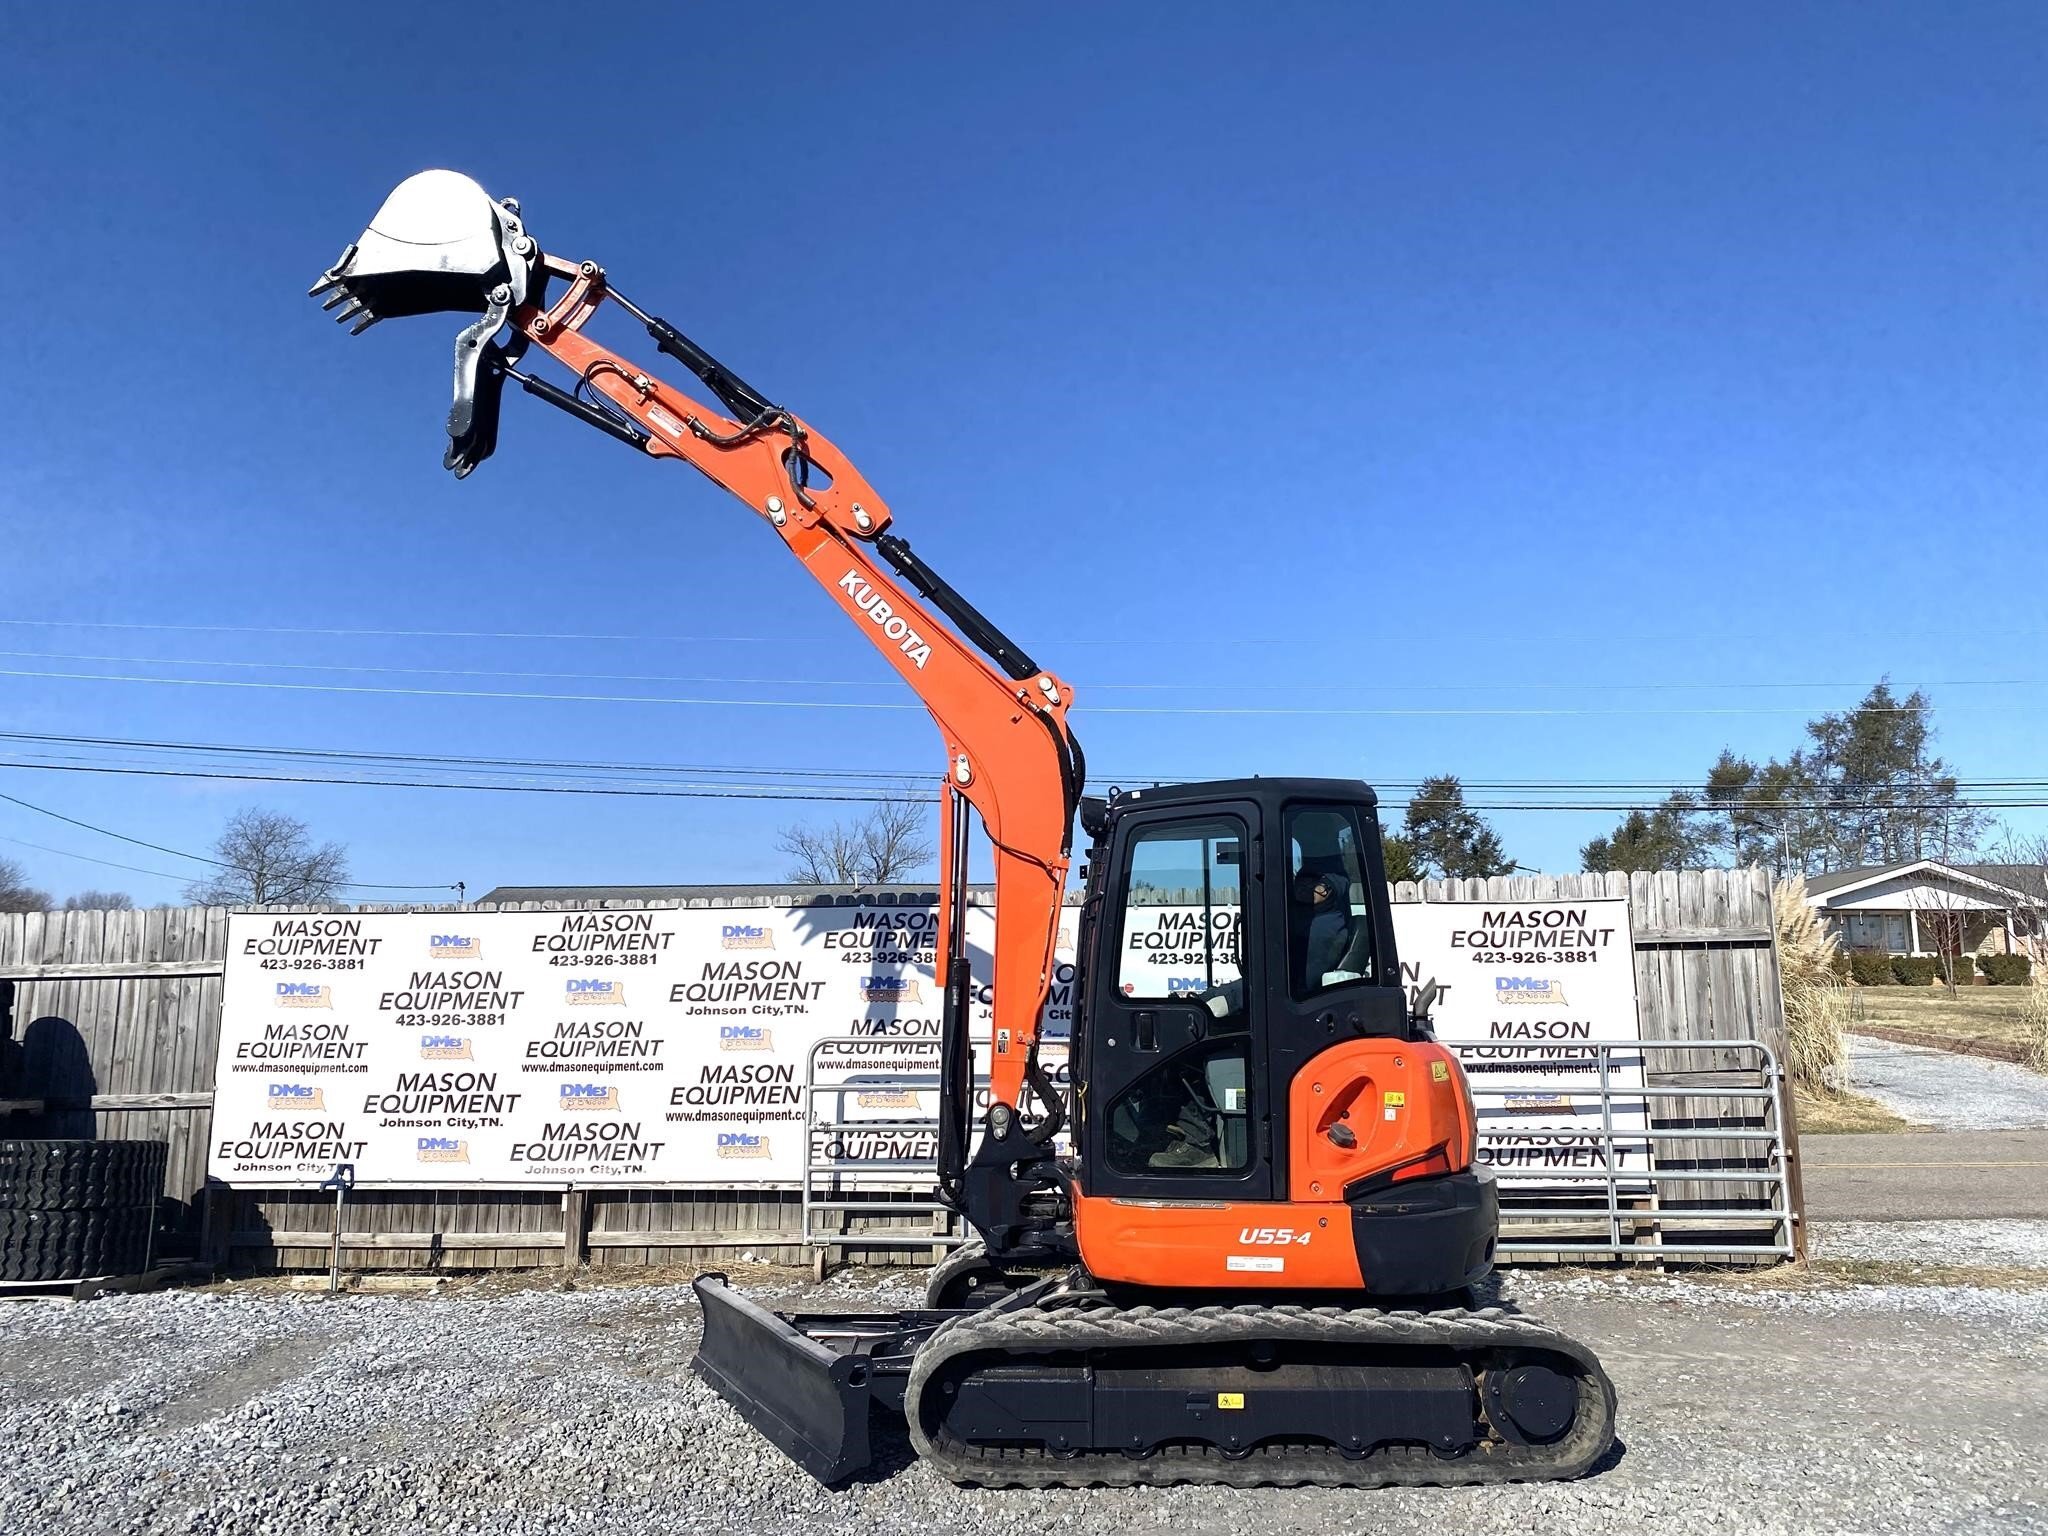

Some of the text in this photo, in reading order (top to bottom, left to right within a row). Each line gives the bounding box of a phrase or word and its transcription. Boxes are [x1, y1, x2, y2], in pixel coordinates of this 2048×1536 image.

[838, 568, 933, 670] KUBOTA
[562, 914, 653, 932] MASON
[1482, 910, 1587, 929] MASON
[272, 920, 361, 937] MASON
[243, 939, 382, 955] EQUIPMENT
[532, 932, 675, 952] EQUIPMENT
[823, 931, 939, 949] EQUIPME
[1450, 929, 1615, 948] EQUIPMENT
[260, 959, 364, 970] 423-926-3881
[549, 953, 657, 966] 423-926-3881
[1472, 951, 1597, 964] 423-926-3881
[701, 961, 801, 981] MASON
[409, 971, 502, 989] MASON
[379, 991, 525, 1010] EQUIPMENT
[669, 981, 826, 1003] EQUIPMENT
[685, 1005, 809, 1016] Johnson City,TN.
[395, 1013, 505, 1026] 423-926-3881
[850, 1019, 941, 1036] MASON
[264, 1024, 349, 1041] MASON
[554, 1021, 643, 1039] MASON
[1489, 1021, 1591, 1039] MASON
[236, 1042, 368, 1058] EQUIPMENT
[526, 1040, 664, 1057] EQUIPMENT
[231, 1062, 369, 1075] www.dmasonequipment.com
[522, 1061, 664, 1074] www.dmasonequipment.com
[700, 1064, 794, 1084] MASON
[396, 1073, 497, 1092] MASON
[363, 1094, 521, 1113] EQUIPMENT
[670, 1085, 806, 1105] EQUIPMEN
[250, 1122, 345, 1139] MASON
[379, 1118, 504, 1129] Johnson City,TN.
[542, 1122, 641, 1141] MASON
[218, 1142, 368, 1159] EQUIPMENT
[509, 1143, 665, 1162] EQUIPMENT
[233, 1162, 337, 1173] Johnson City,T
[525, 1165, 585, 1175] Johnson
[1239, 1228, 1311, 1245] U55-4
